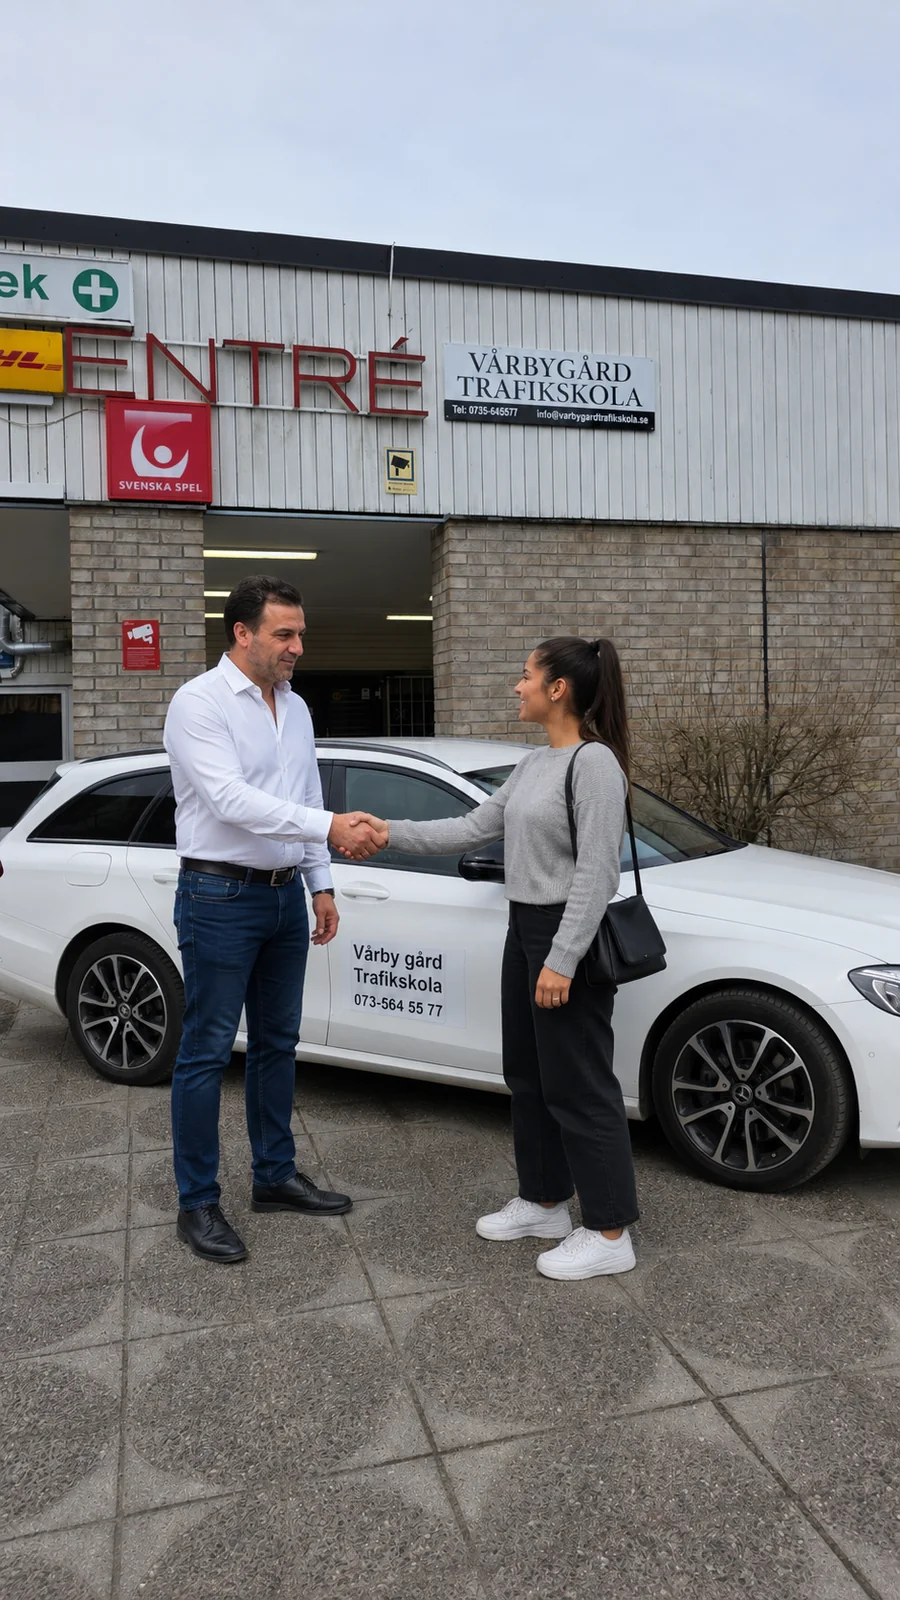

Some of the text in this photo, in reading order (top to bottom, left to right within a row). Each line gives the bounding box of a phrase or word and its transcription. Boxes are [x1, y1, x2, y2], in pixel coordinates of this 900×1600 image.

[0, 263, 49, 300] ek
[65, 326, 429, 418] ENTRÉ
[468, 347, 631, 383] VÅRBYGÅRD
[456, 375, 643, 407] TRAFIKSKOLA
[452, 404, 649, 425] Tel: 0735-645577 info@varbygardtrafikskola.se
[119, 480, 203, 493] SVENSKA SPEL
[353, 943, 442, 970] Vårby gård
[353, 967, 442, 994] Trafikskola
[354, 993, 443, 1017] 073-564 55 77
